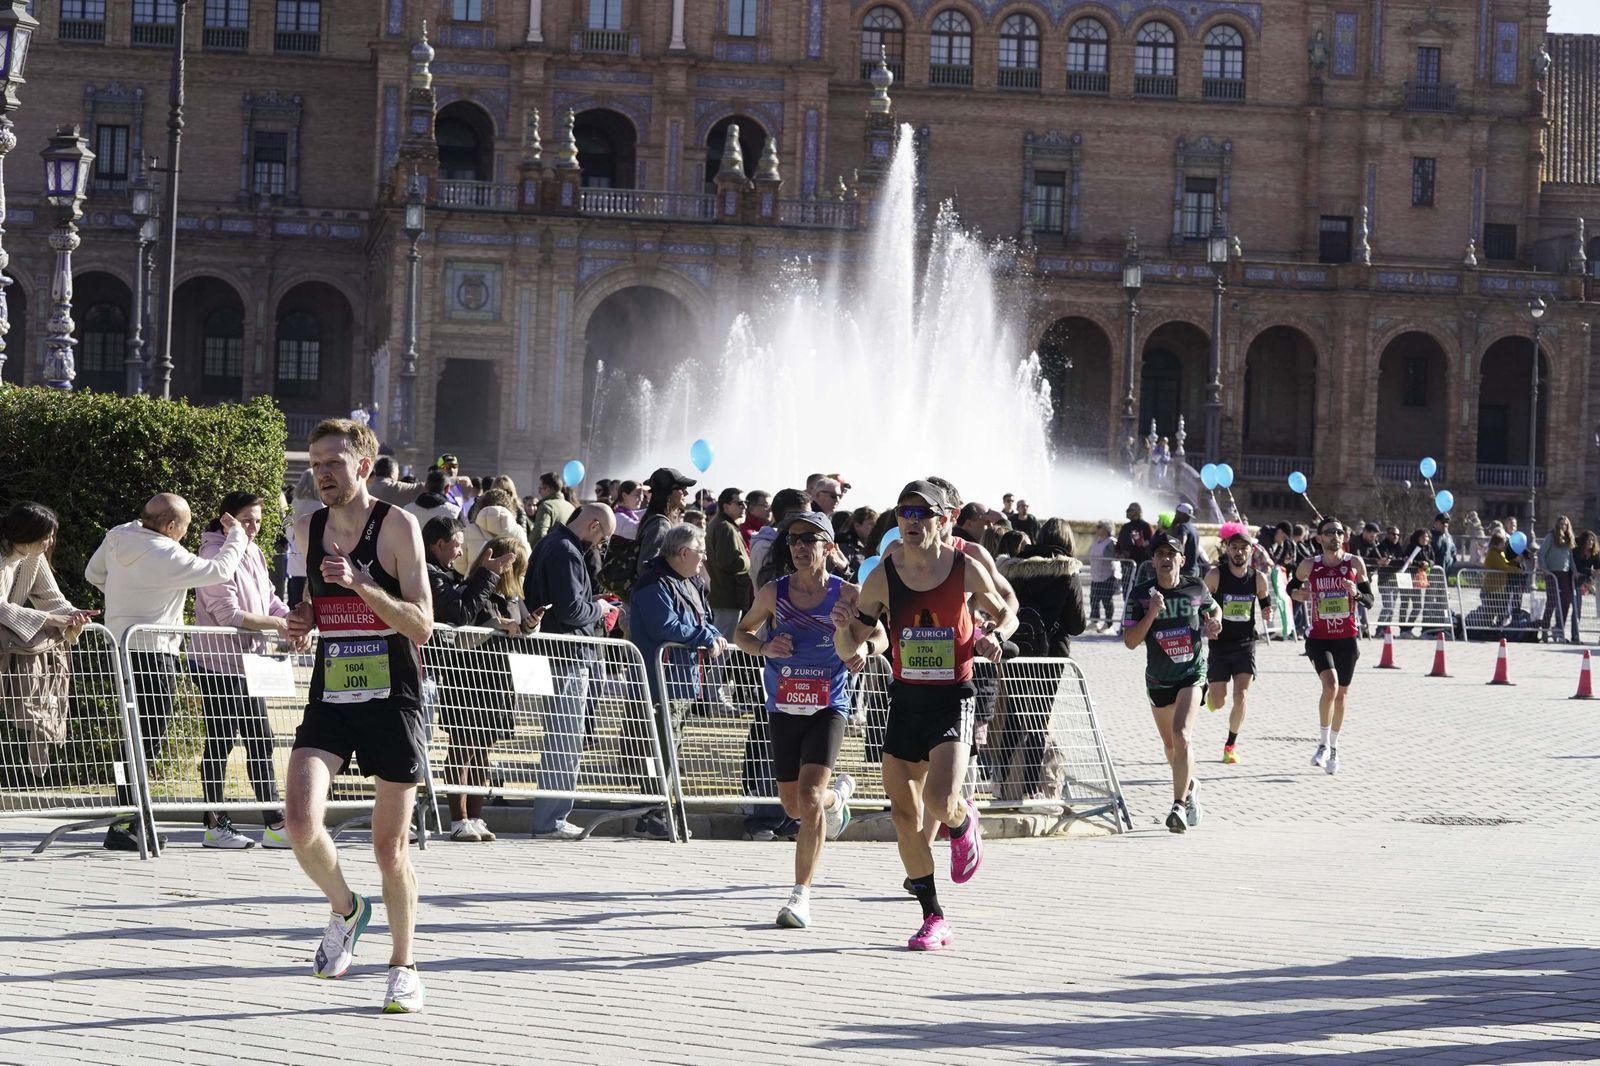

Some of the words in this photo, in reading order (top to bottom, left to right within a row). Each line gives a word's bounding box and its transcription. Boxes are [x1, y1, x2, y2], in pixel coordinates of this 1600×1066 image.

[320, 614, 375, 625] WINDMILERS
[915, 630, 947, 638] ZURICH
[343, 644, 380, 654] ZURICH
[917, 645, 934, 653] 1704
[908, 656, 943, 667] GREGO
[344, 663, 364, 672] 1604
[794, 668, 824, 677] ZURICH
[343, 675, 368, 688] JON
[794, 683, 811, 691] 1025
[786, 692, 819, 704] OSCAR
